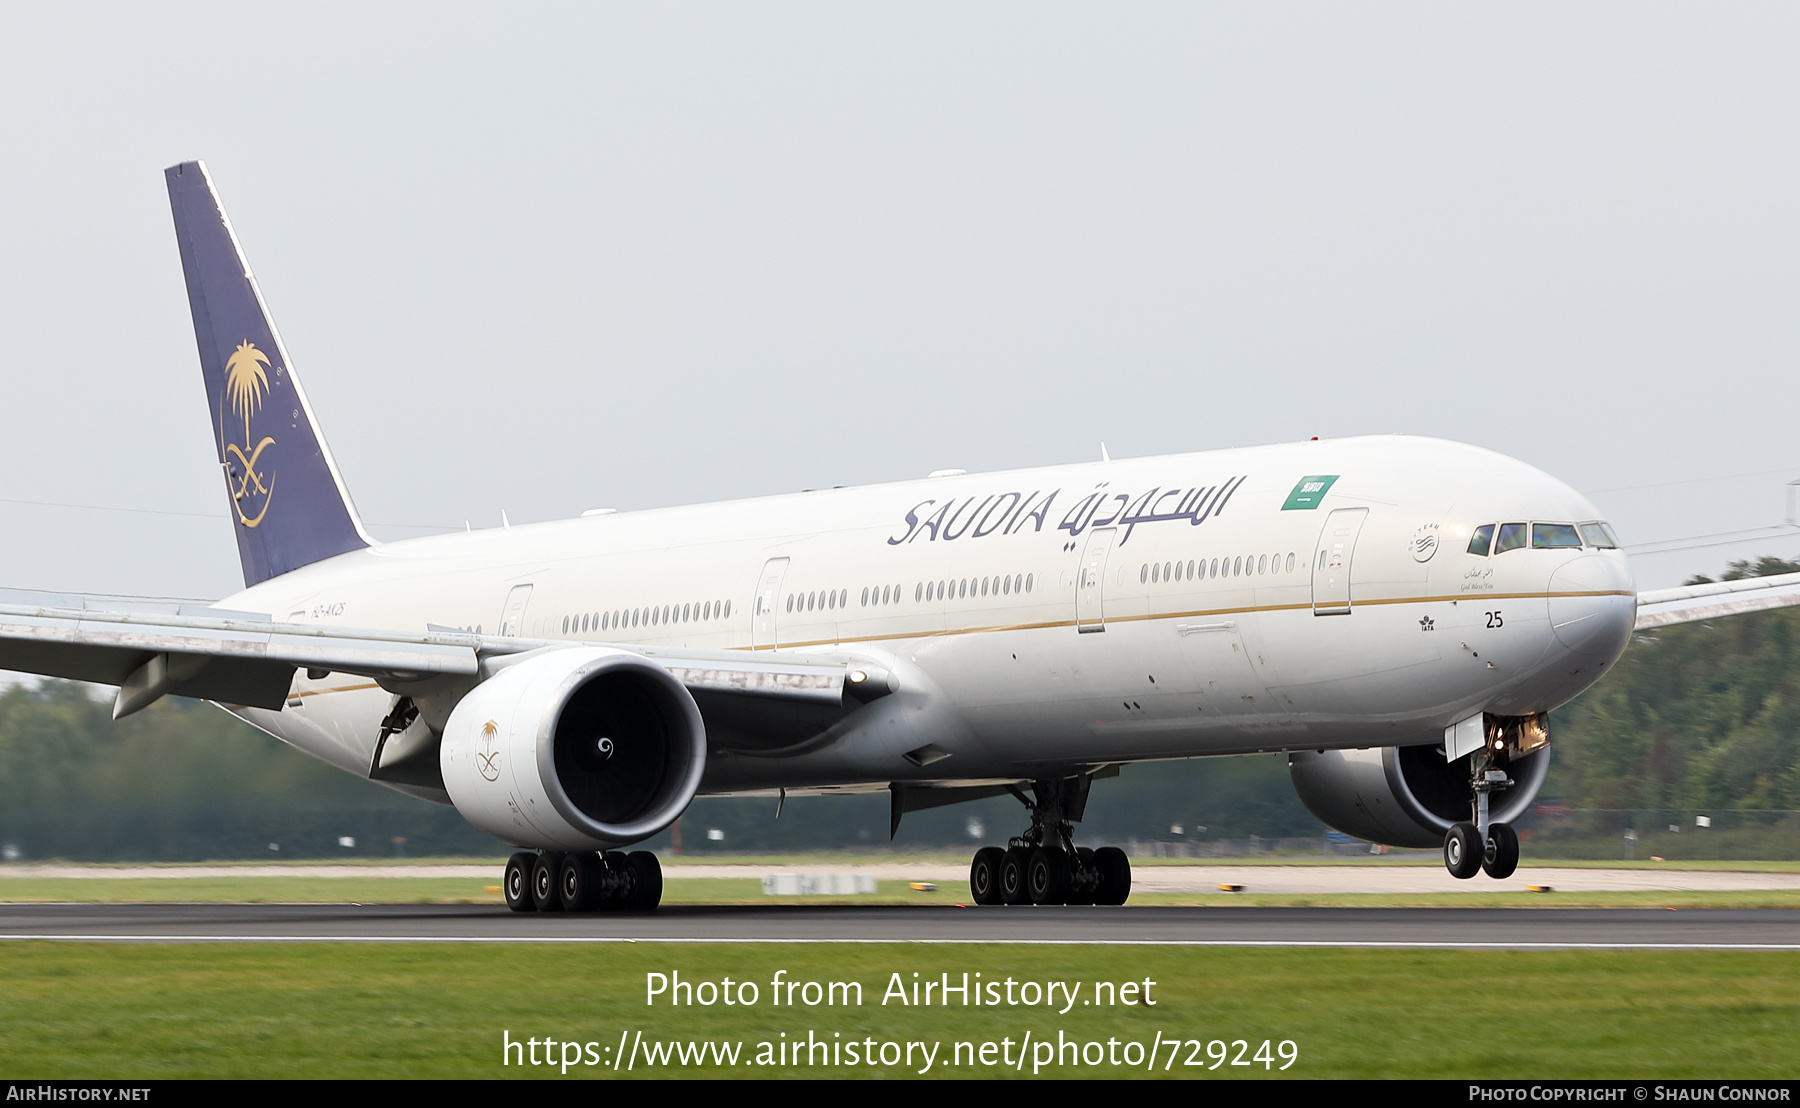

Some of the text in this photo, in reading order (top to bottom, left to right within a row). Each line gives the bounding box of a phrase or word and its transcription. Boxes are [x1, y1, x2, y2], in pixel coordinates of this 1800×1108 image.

[886, 487, 1061, 546] SAUDIA
[1057, 475, 1248, 552] السعودية
[1485, 610, 1504, 629] 25
